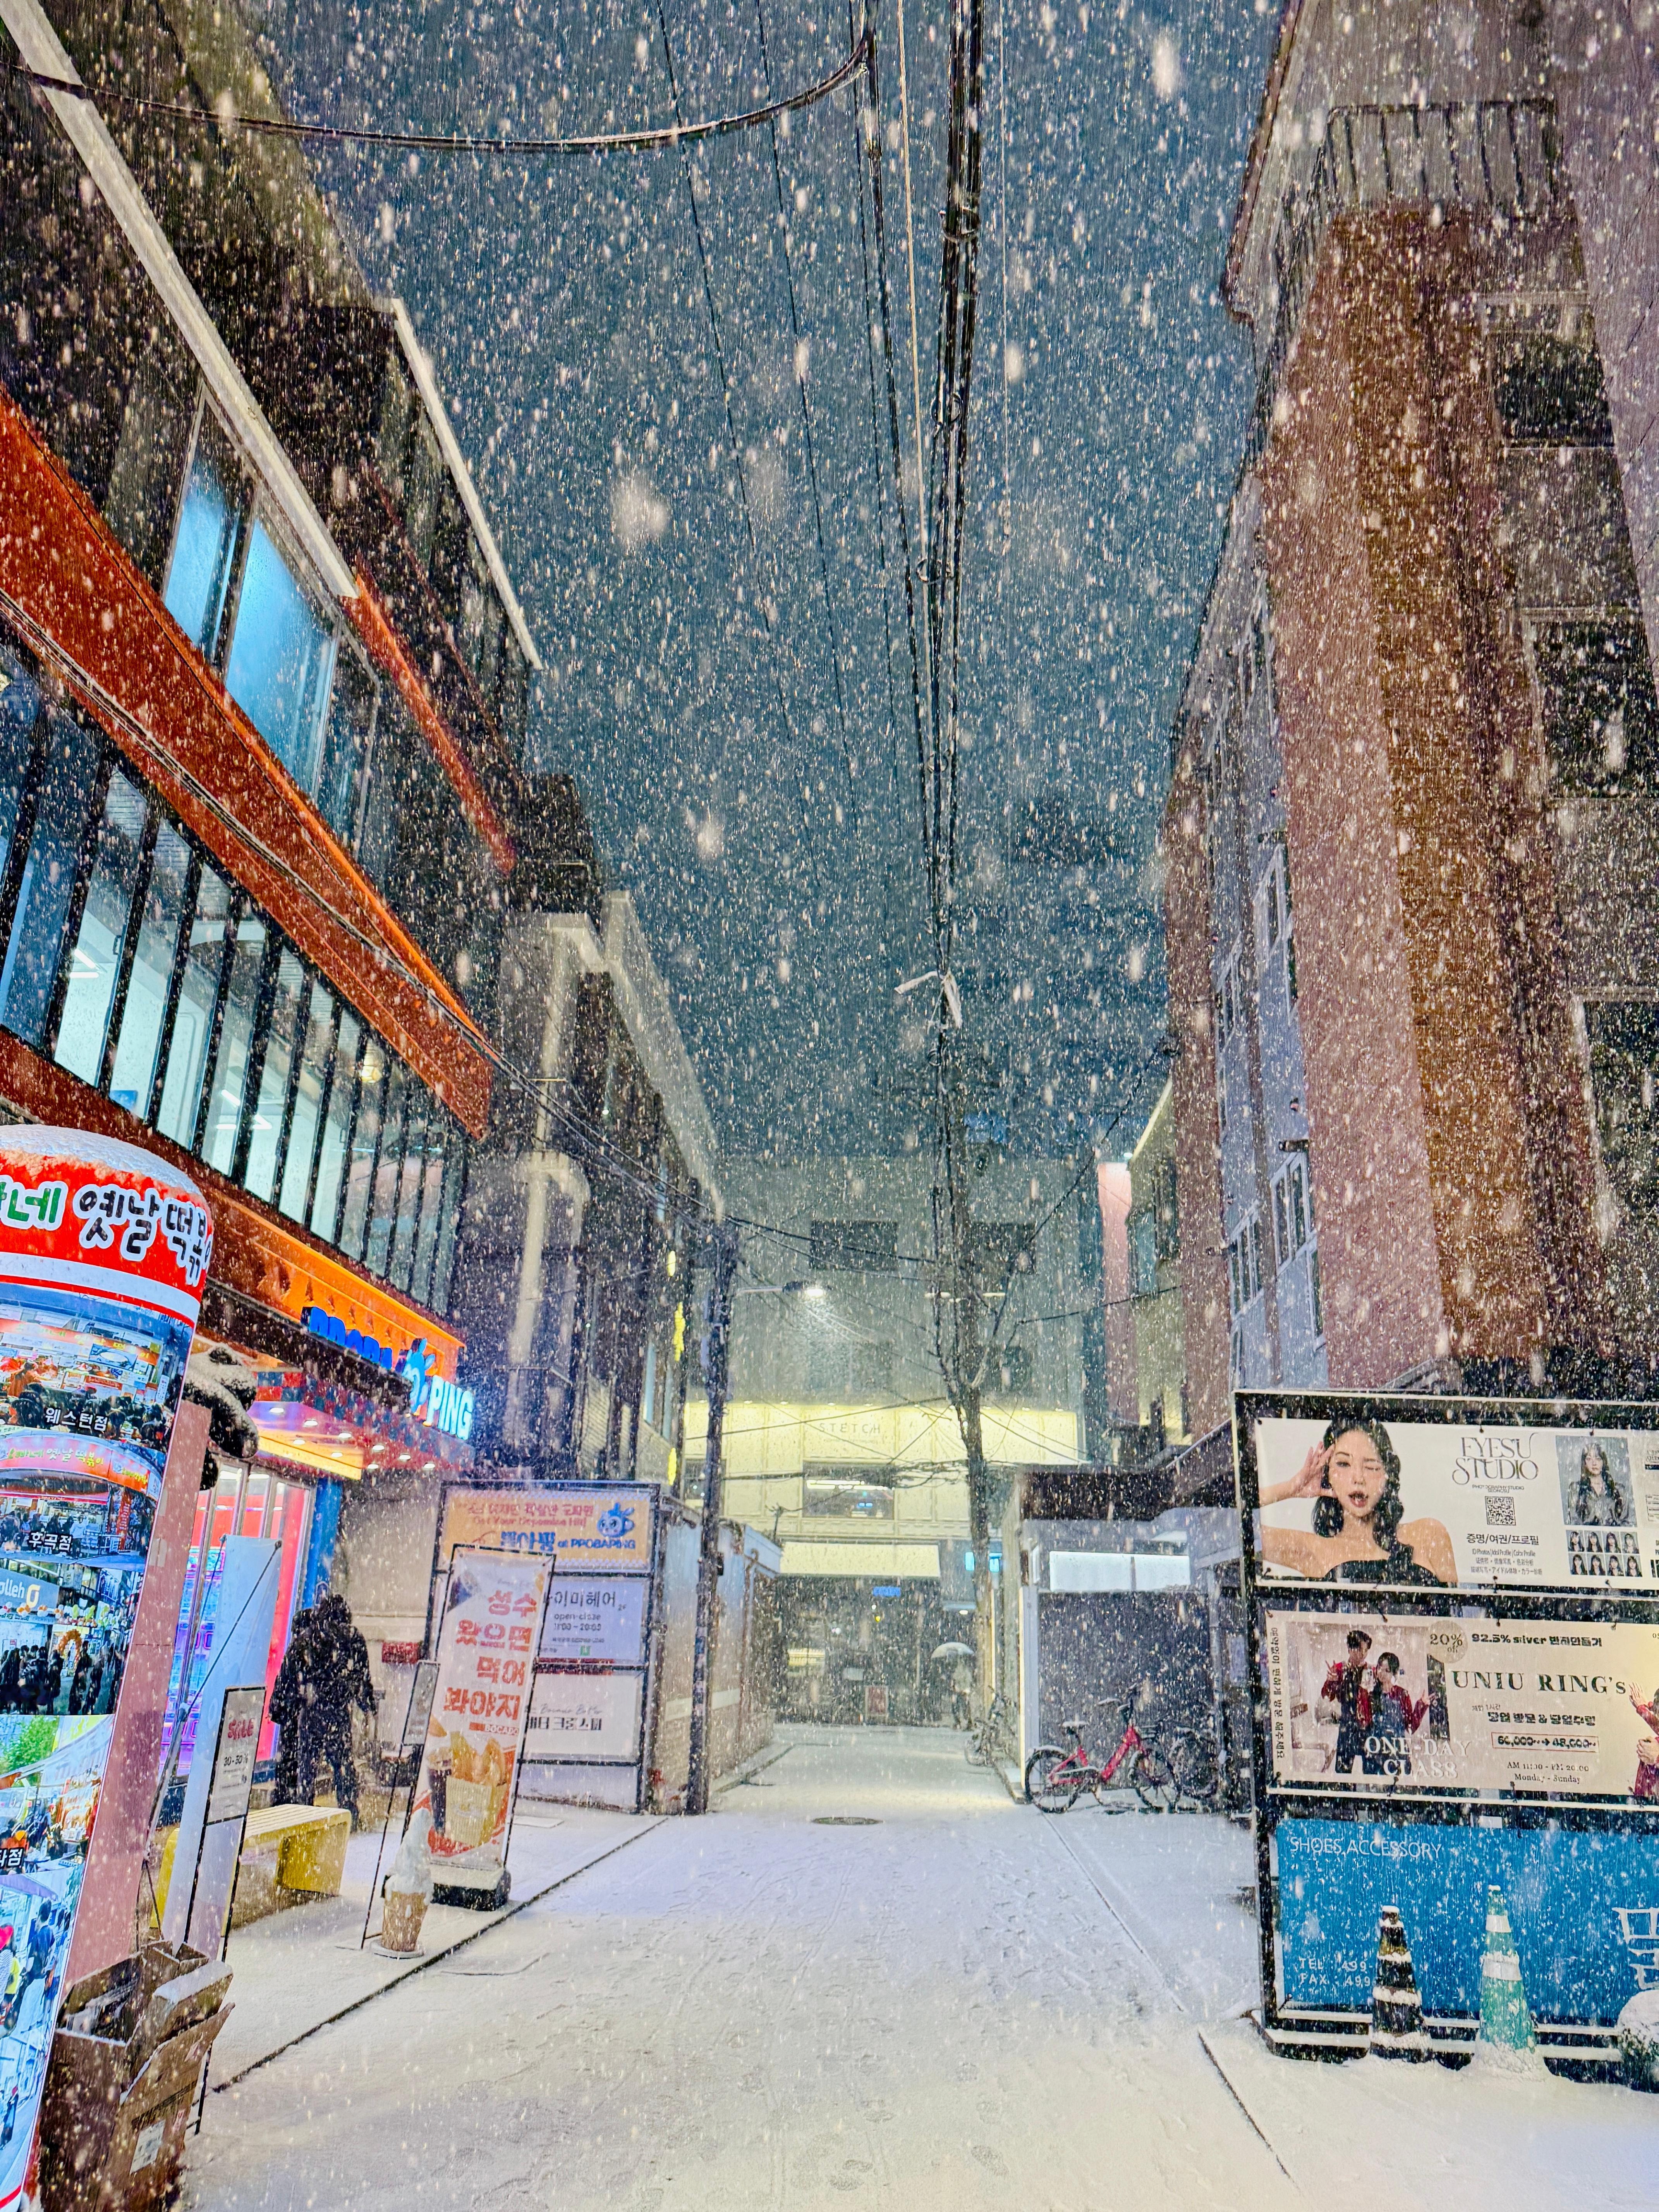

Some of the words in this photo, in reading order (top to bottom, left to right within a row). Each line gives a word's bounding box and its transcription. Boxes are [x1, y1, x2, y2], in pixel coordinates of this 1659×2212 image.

[425, 1375, 473, 1440] PING
[45, 1408, 108, 1431] 웨스턴점
[820, 1423, 880, 1433] STETCH
[1452, 1457, 1539, 1485] STUDIO
[29, 1532, 72, 1551] 후곡점
[1467, 1534, 1539, 1545] 증명/여권/프로필
[488, 1590, 537, 1618] 성수
[456, 1619, 532, 1652] 왔으면
[1430, 1633, 1463, 1646] 20%
[1472, 1633, 1511, 1644] 92.5%
[1513, 1635, 1547, 1644] silver
[477, 1656, 525, 1686] 먹어
[443, 1687, 520, 1720] 봐야지
[1384, 1759, 1458, 1778] CLASS
[1515, 1773, 1545, 1783] Monday
[1554, 1775, 1580, 1783] Sunday
[1299, 1958, 1324, 1970] TEL
[1299, 1973, 1327, 1985] FAX
